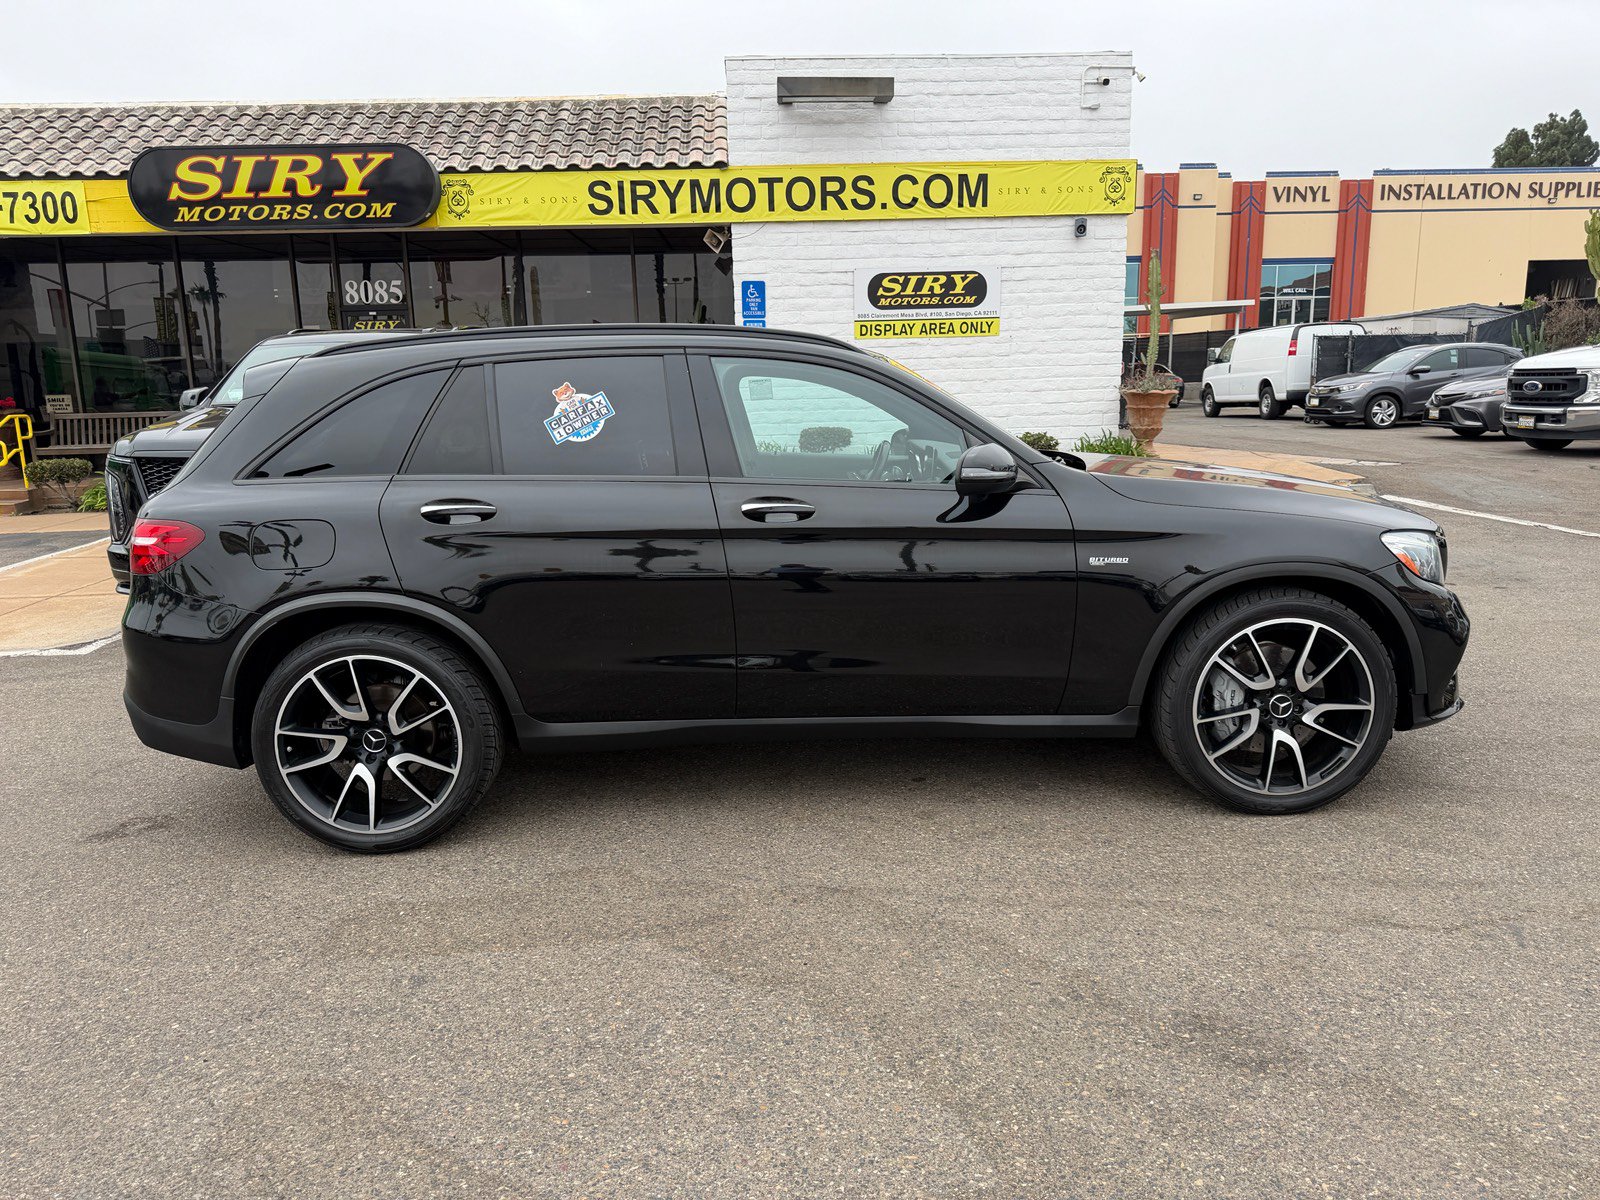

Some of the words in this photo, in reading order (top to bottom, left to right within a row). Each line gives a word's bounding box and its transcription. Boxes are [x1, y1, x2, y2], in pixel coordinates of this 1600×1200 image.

[167, 151, 395, 201] SIRY
[479, 197, 513, 206] SIRY
[523, 196, 530, 205] &
[540, 195, 579, 204] SONS
[587, 173, 989, 216] SIRYMOTORS.COM
[998, 186, 1031, 196] SIRY
[1040, 186, 1048, 195] &
[1057, 185, 1094, 194] SONS
[1272, 185, 1331, 203] VINYL
[1380, 182, 1521, 201] INSTALLATION
[173, 202, 397, 222] MOTORS.COM
[344, 279, 404, 305] 8085
[877, 273, 978, 296] SIRY
[877, 295, 977, 306] MOTORS.COM
[353, 320, 400, 331] SIRY
[859, 323, 917, 337] DISPLAY
[919, 321, 956, 336] AREA
[959, 321, 995, 335] ONLY
[550, 399, 604, 429] CARFAX
[564, 406, 608, 433] OWNER
